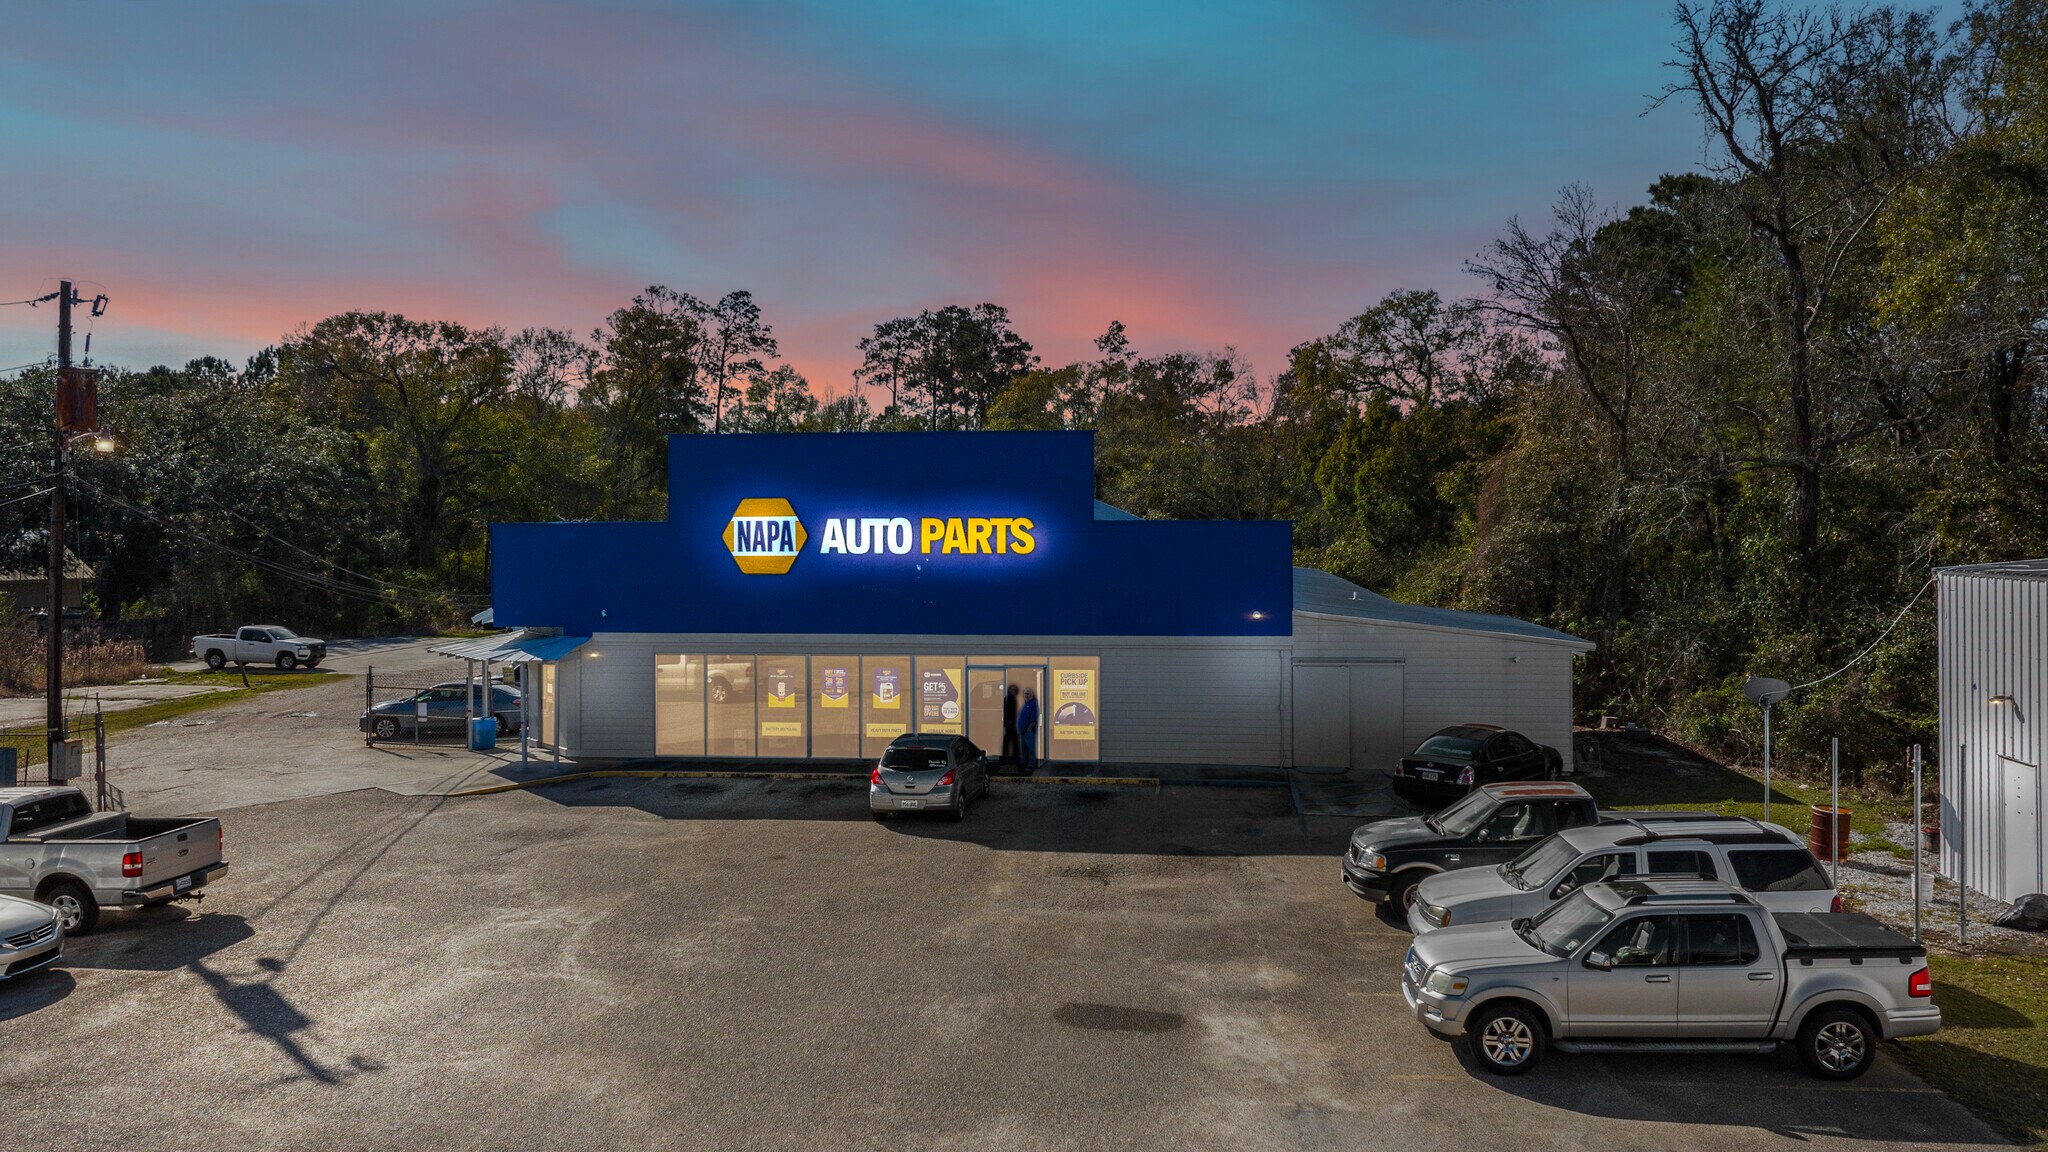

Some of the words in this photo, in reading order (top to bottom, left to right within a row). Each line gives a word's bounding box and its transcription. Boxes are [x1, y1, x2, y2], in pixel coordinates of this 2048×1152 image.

[737, 520, 794, 553] NAPA
[820, 518, 912, 555] AUTO
[921, 518, 1035, 555] PARTS
[923, 682, 938, 691] GET
